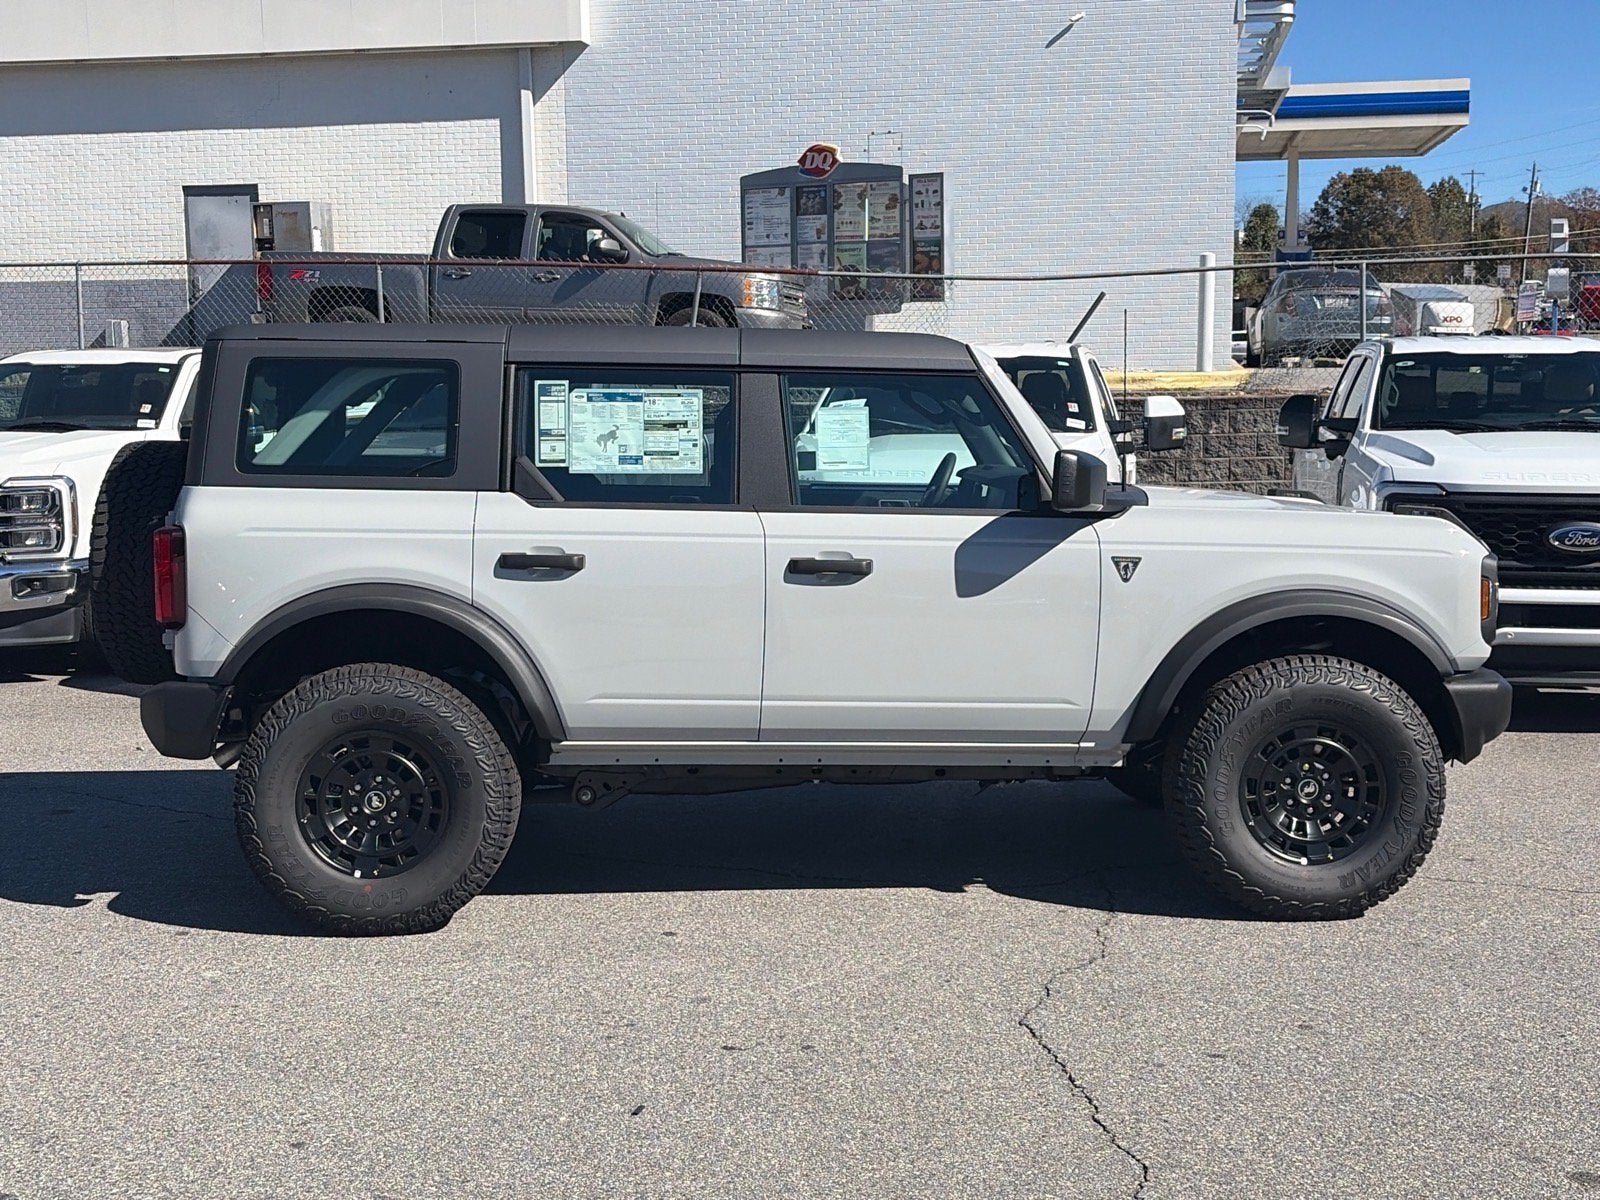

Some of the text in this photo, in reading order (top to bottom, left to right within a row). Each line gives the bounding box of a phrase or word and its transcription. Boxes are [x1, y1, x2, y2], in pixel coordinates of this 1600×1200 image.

[804, 151, 833, 170] DQ
[289, 269, 320, 280] Z71
[1442, 315, 1463, 324] XPO
[648, 398, 657, 406] 18
[1564, 530, 1599, 546] Ford
[331, 702, 474, 790] GOODYEAR
[1213, 698, 1295, 839] GOODYEAR
[1336, 751, 1420, 890] GOODYEAR
